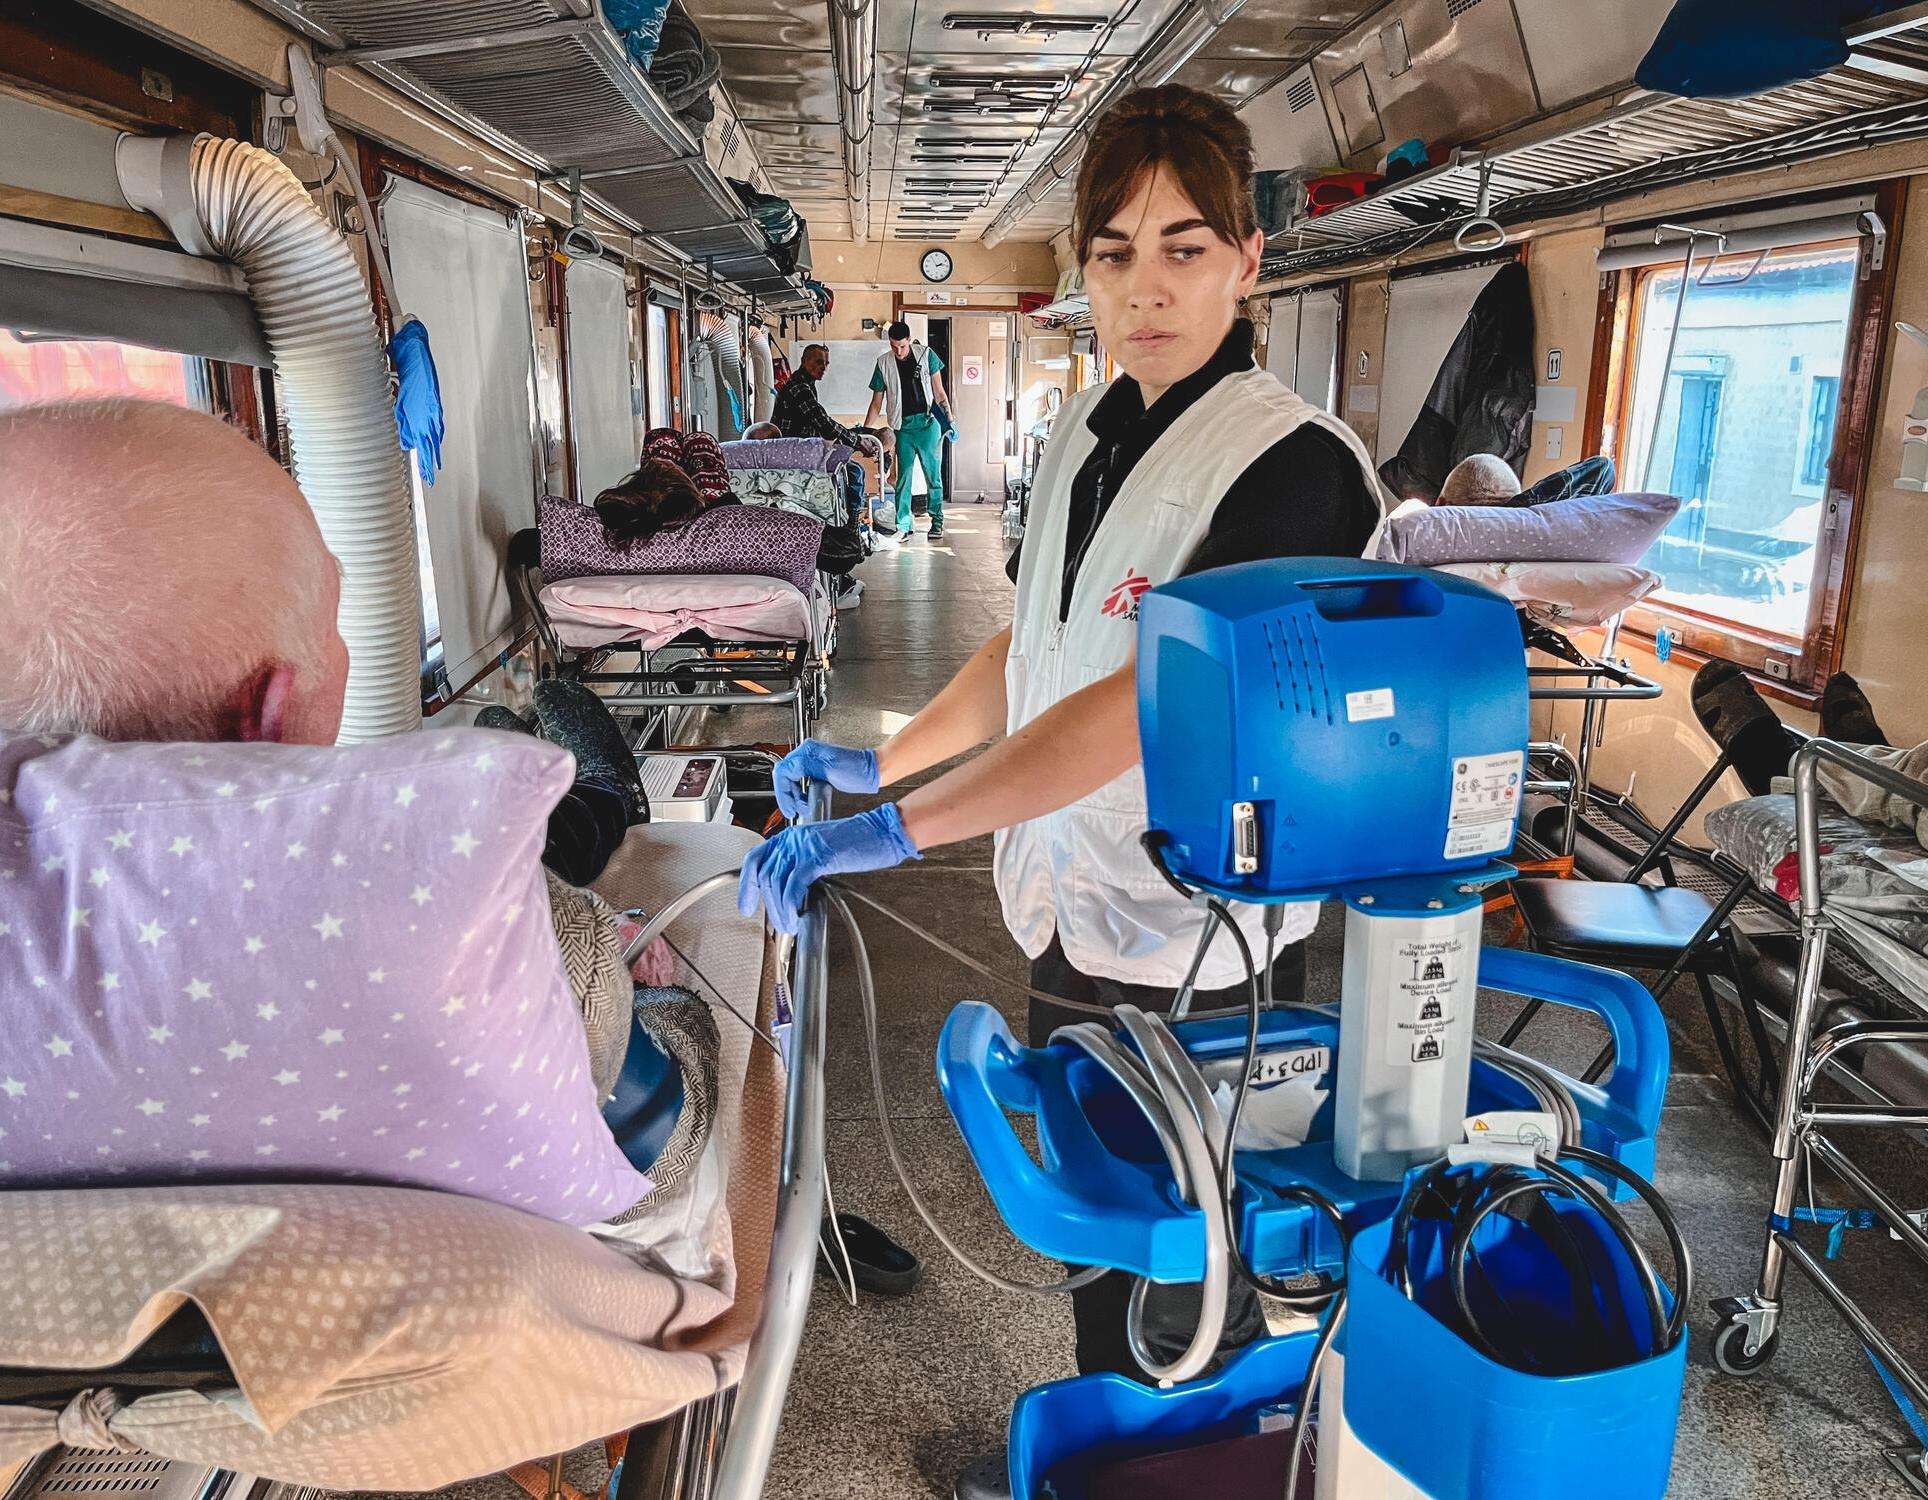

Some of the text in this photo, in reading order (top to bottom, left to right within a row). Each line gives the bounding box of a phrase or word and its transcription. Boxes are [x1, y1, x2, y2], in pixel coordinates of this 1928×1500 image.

[1400, 949, 1418, 957] Fully
[1400, 982, 1435, 990] Maximum
[1436, 984, 1452, 993] Load
[1398, 1022, 1433, 1030] Maximum
[1428, 1025, 1445, 1034] Load
